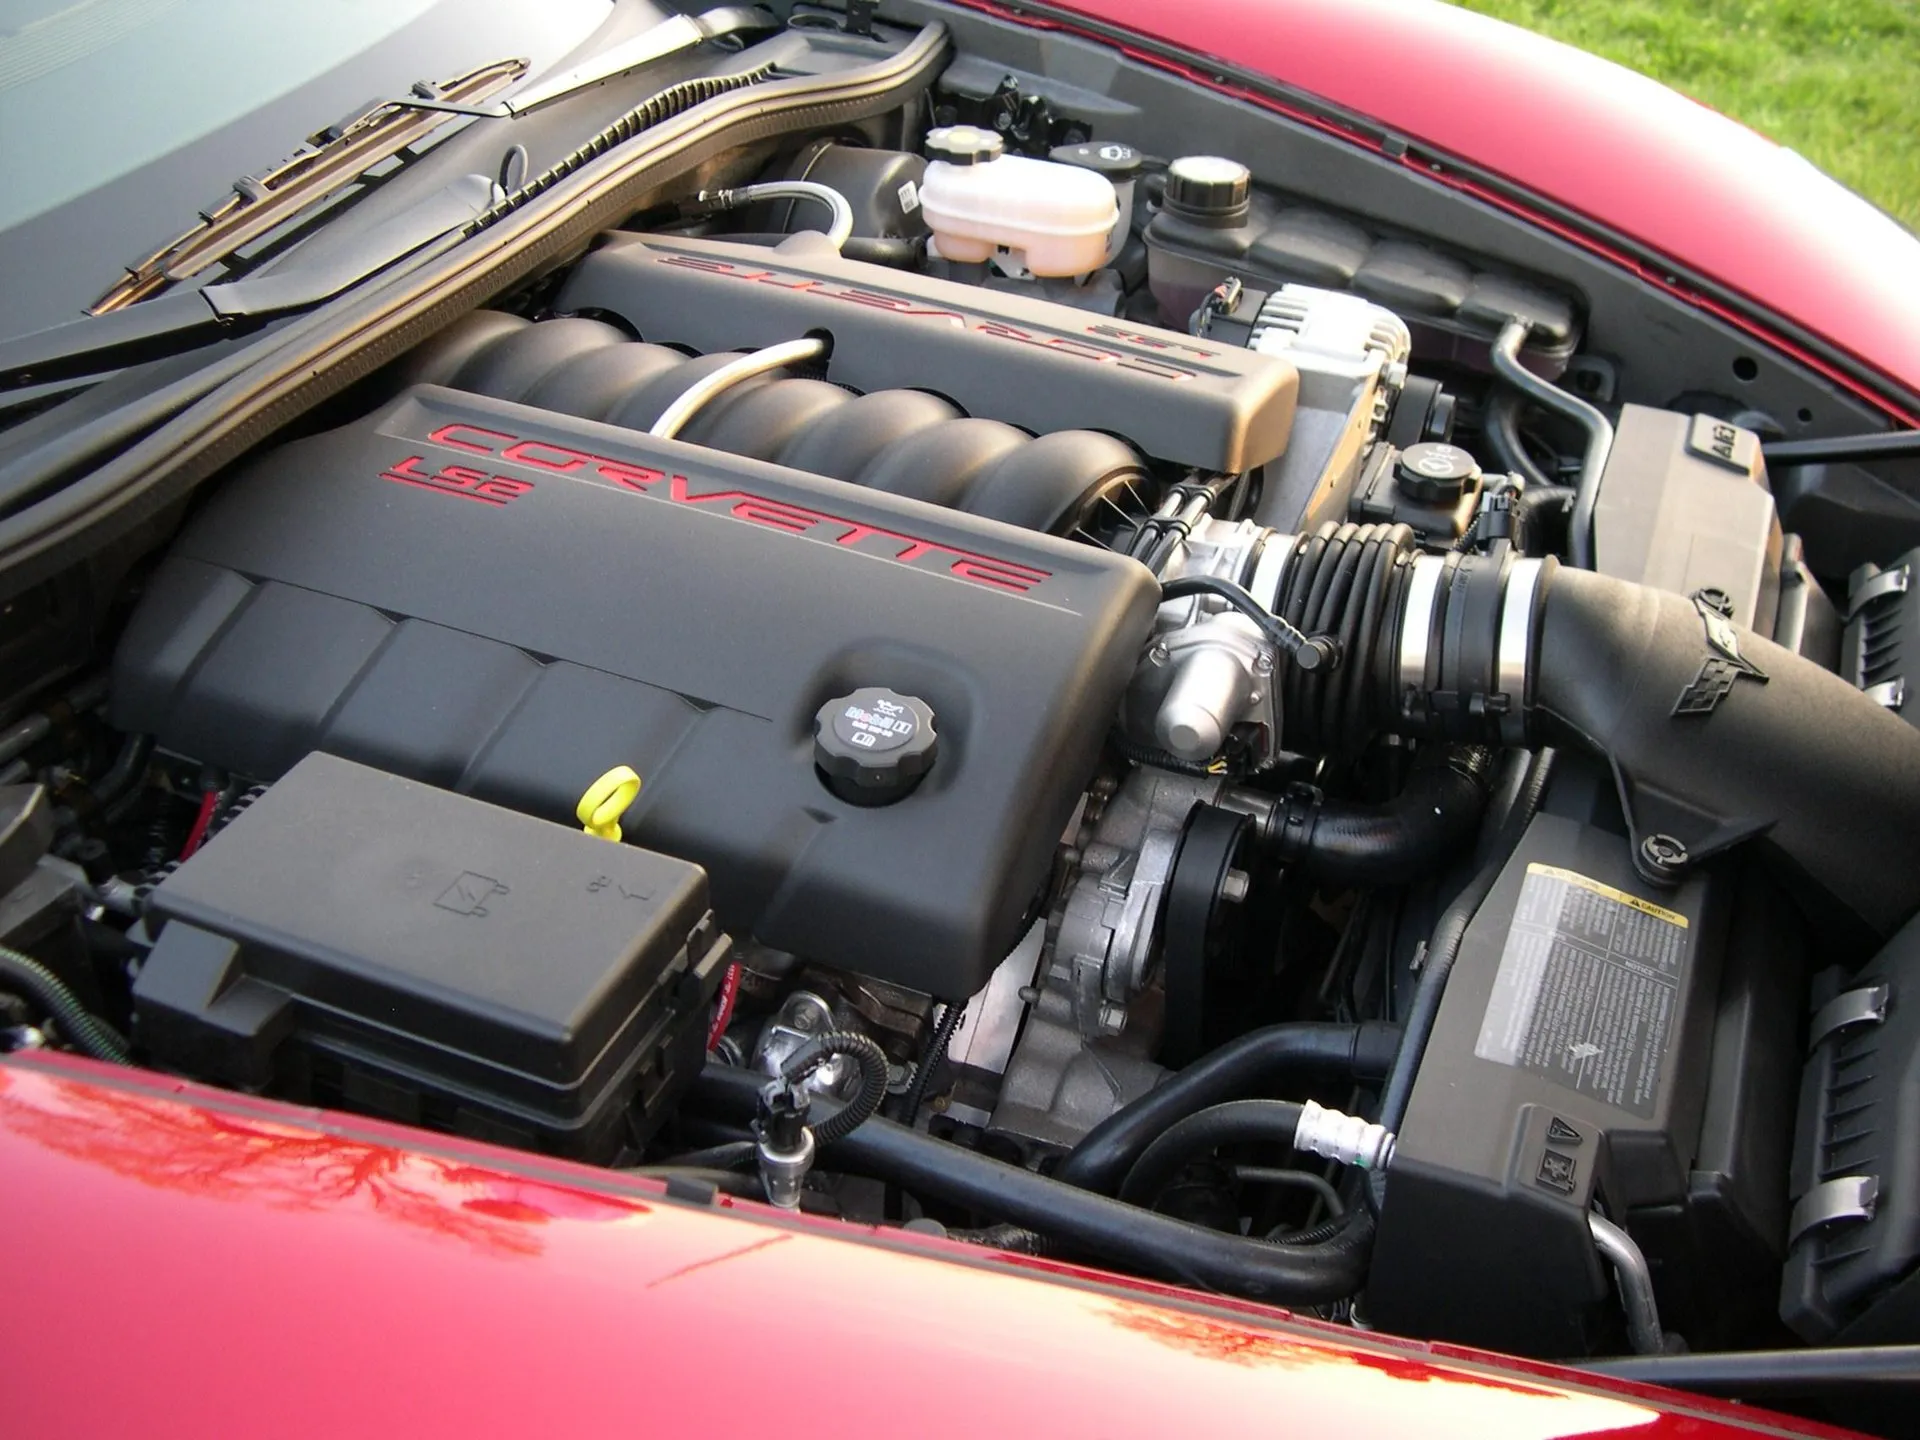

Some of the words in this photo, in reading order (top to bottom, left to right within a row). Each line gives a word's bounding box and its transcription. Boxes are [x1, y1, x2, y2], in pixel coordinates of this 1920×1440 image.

[385, 455, 536, 503] LS2
[427, 422, 1053, 594] CORVETTE
[1641, 902, 1677, 921] CAUTION
[1624, 960, 1656, 976] NOTICE
